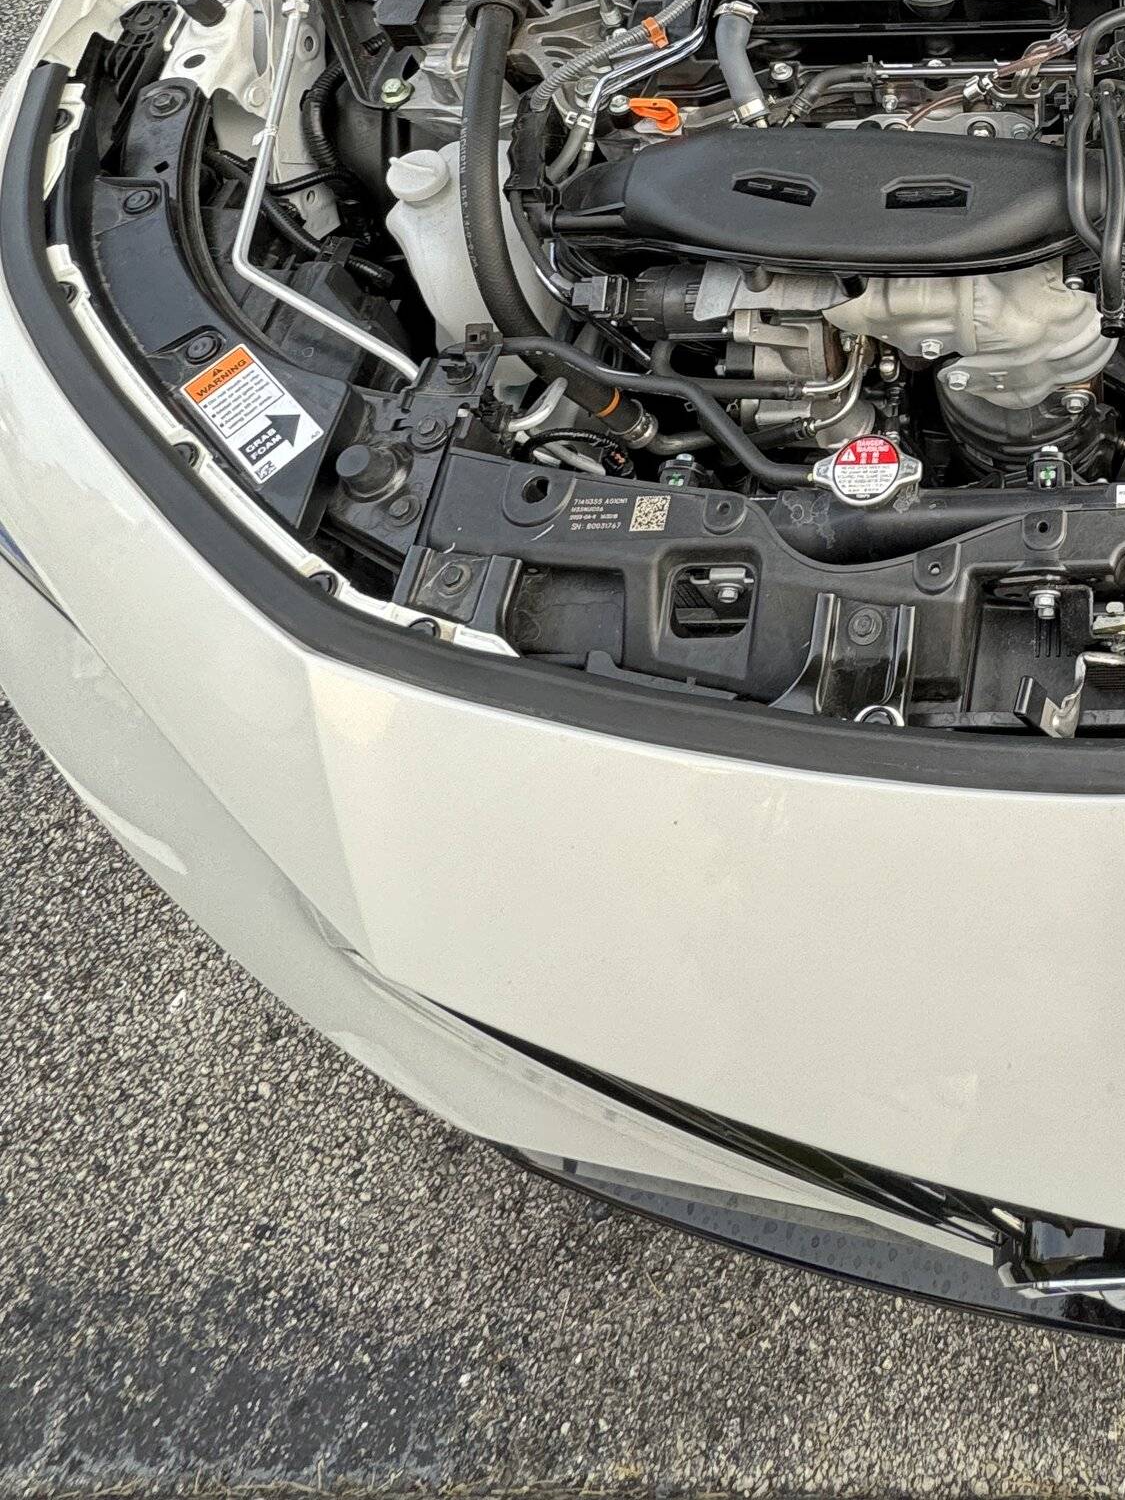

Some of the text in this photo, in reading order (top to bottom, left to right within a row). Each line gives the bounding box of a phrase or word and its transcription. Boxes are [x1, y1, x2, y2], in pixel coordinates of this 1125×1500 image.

[196, 359, 247, 397] WARNING
[245, 428, 277, 453] GRAB
[251, 434, 283, 460] FOAM
